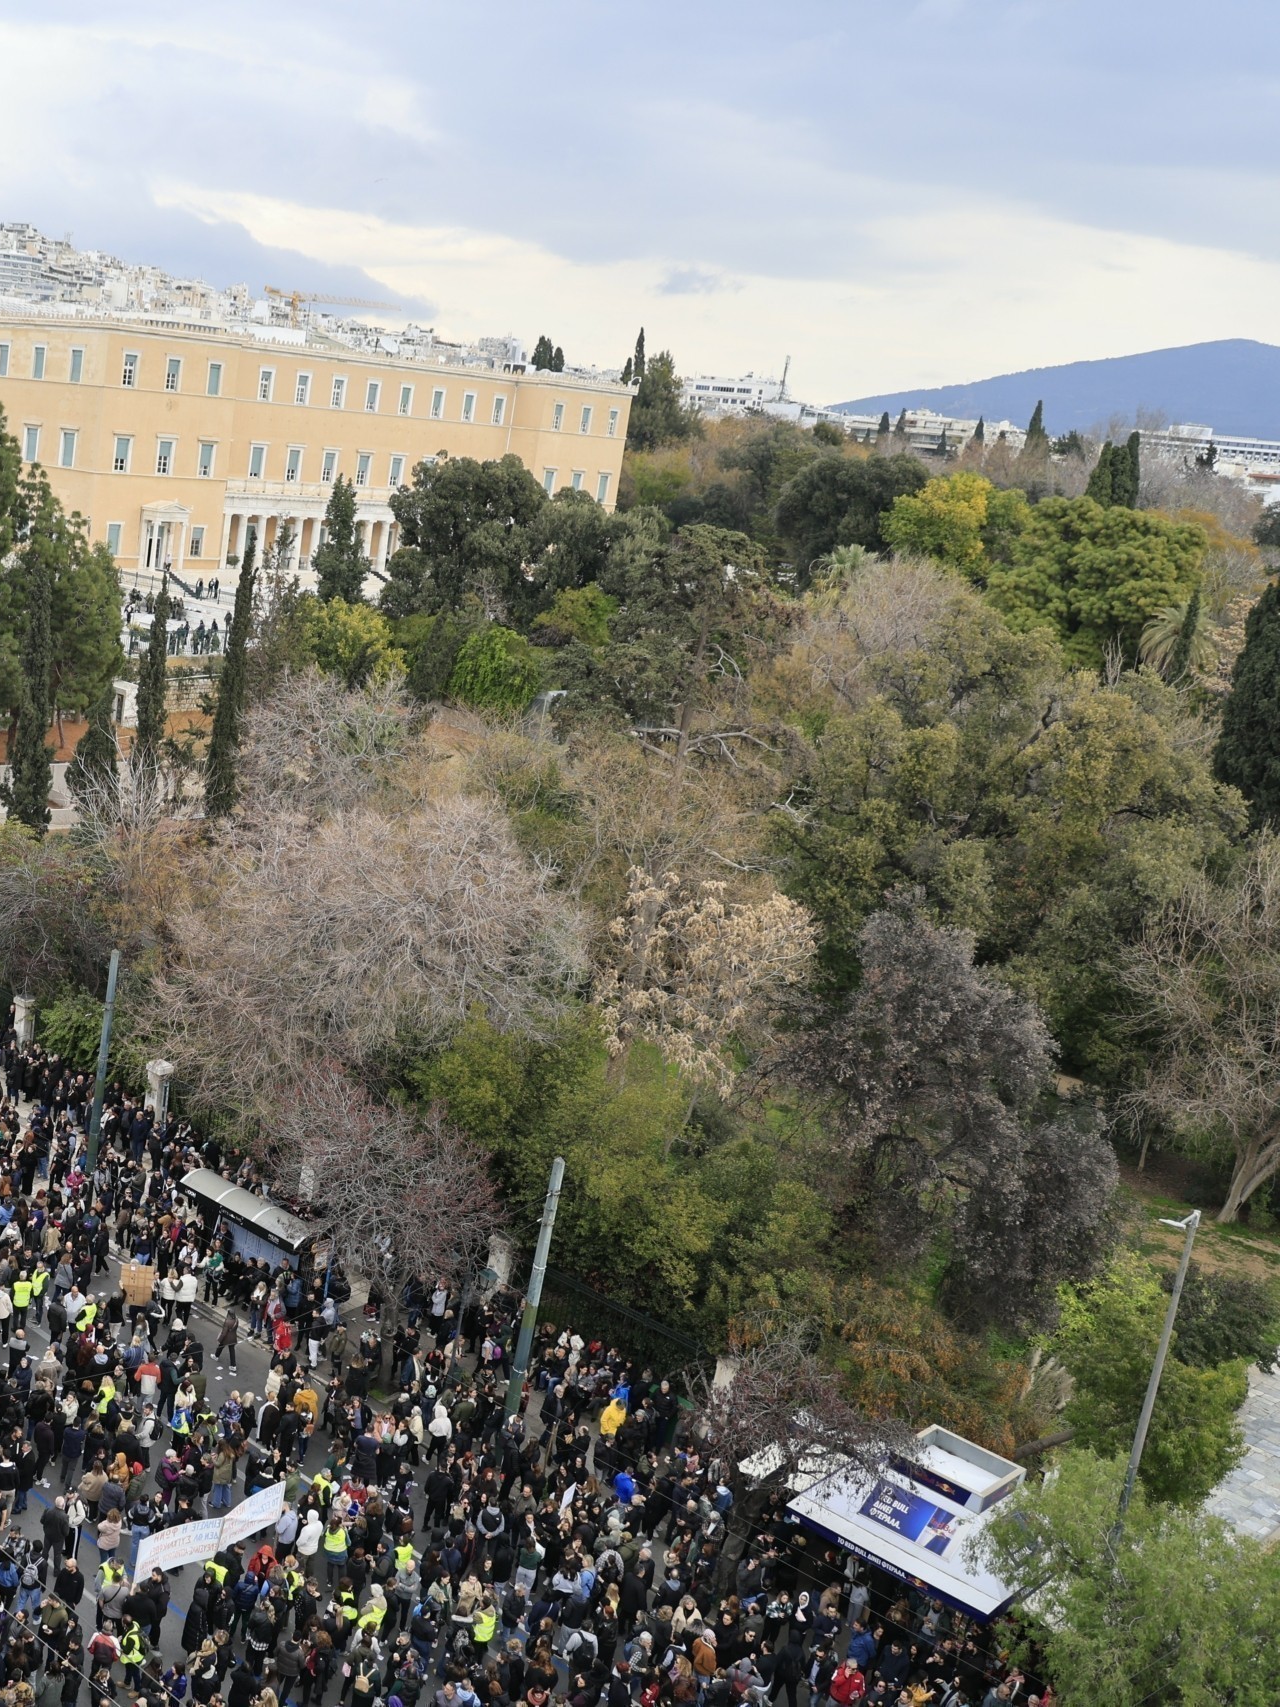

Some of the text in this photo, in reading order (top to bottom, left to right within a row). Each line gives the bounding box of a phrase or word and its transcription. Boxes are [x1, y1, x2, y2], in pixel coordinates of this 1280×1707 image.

[873, 1500, 894, 1514] ΔΙΝΕΙ
[892, 1499, 910, 1514] BULL
[844, 1540, 855, 1551] RED
[855, 1545, 867, 1558] BULL
